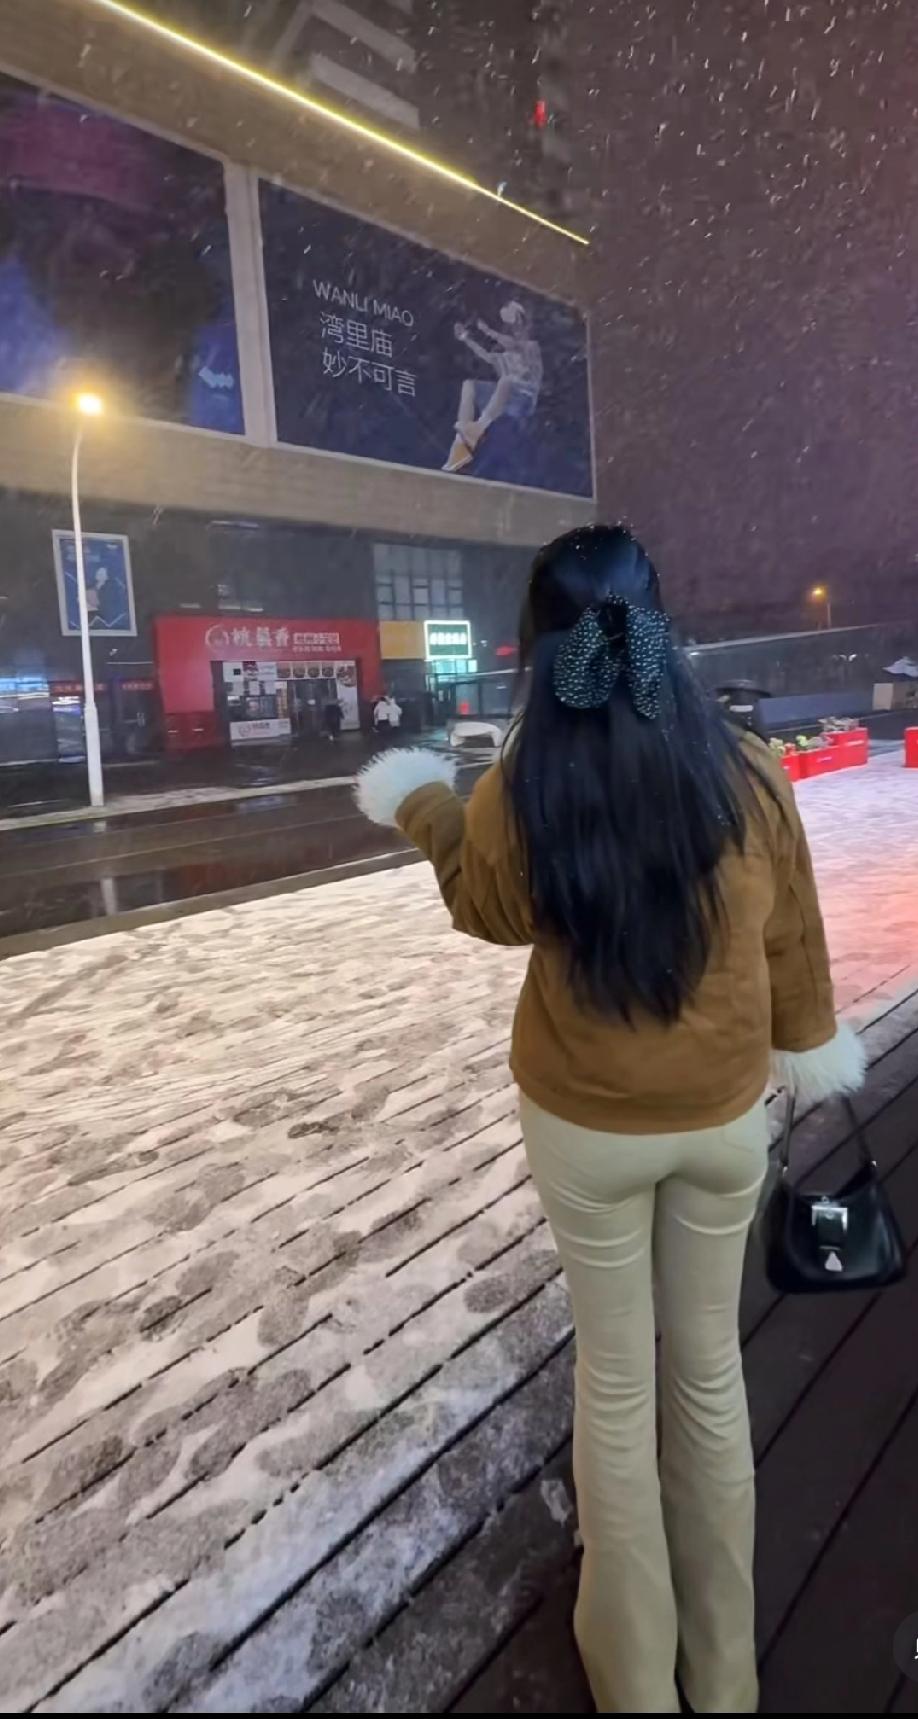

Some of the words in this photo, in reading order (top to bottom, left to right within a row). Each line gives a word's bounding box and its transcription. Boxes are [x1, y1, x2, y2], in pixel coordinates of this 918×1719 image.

[313, 280, 368, 313] WANLI
[373, 299, 414, 327] MIAO
[320, 312, 392, 358] 湾里庙
[323, 347, 416, 397] 妙不可言
